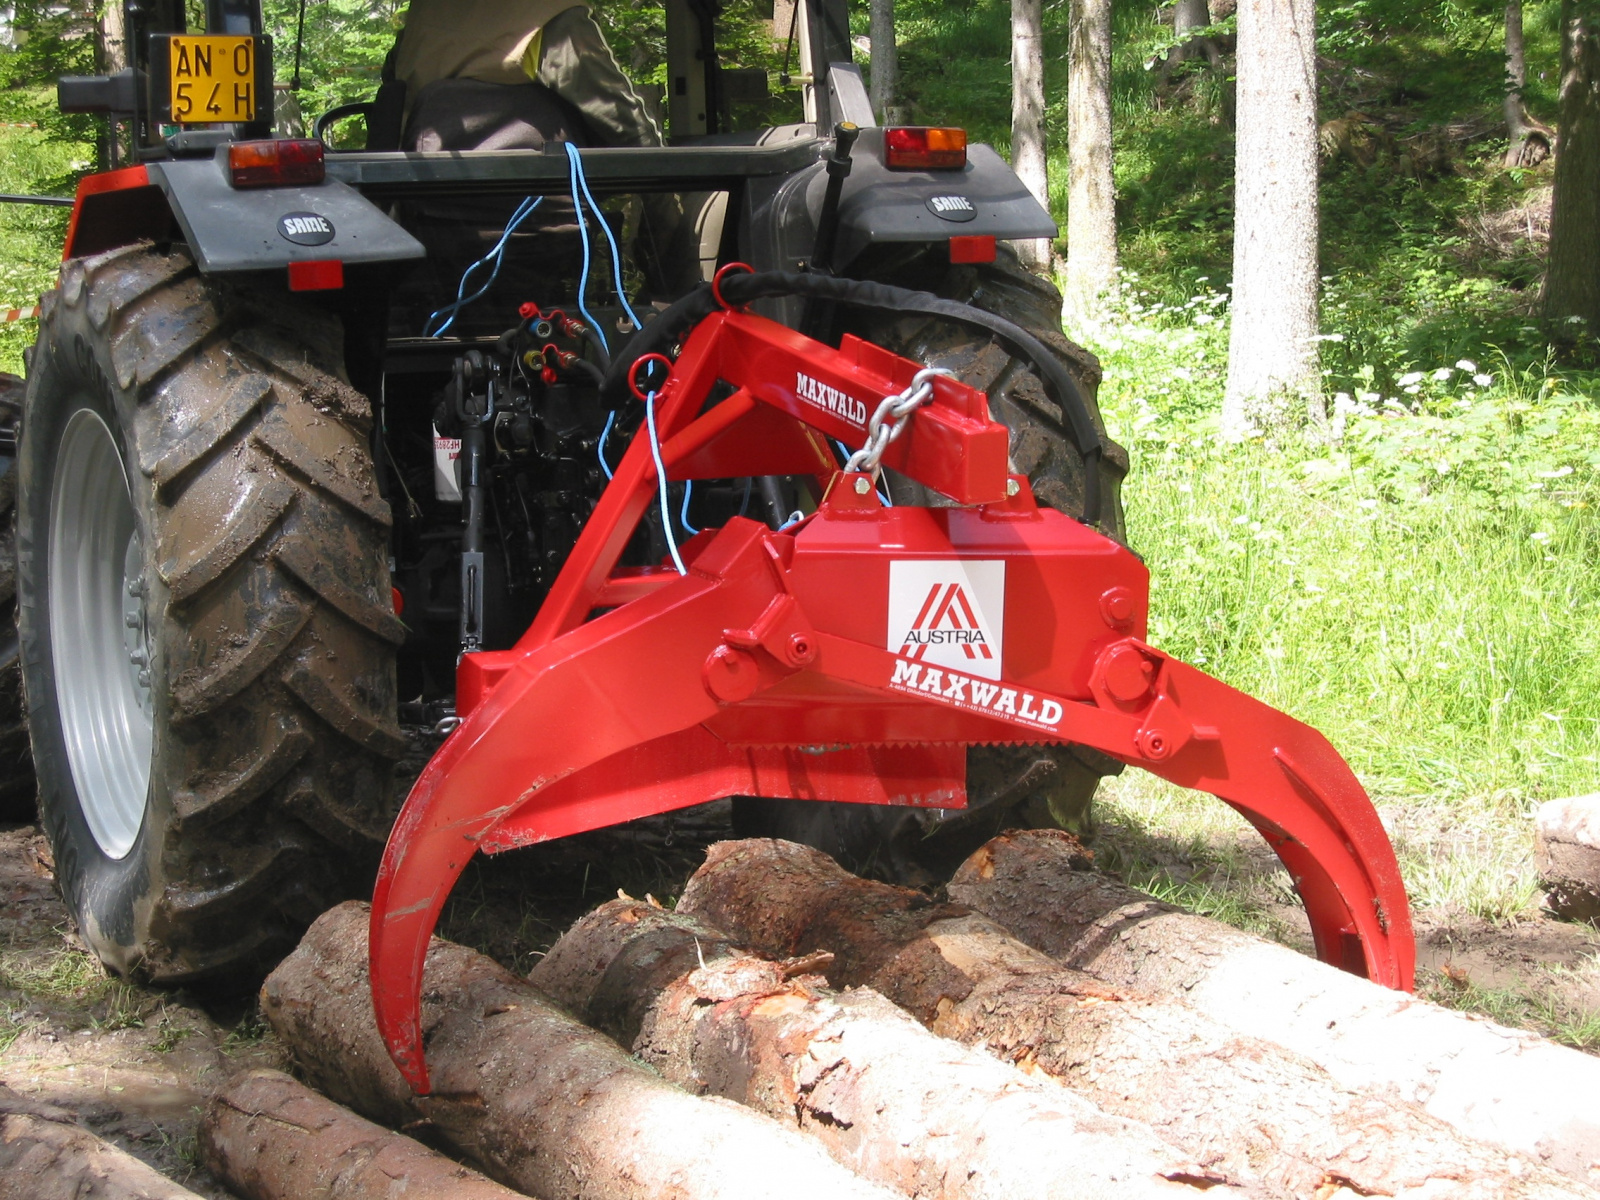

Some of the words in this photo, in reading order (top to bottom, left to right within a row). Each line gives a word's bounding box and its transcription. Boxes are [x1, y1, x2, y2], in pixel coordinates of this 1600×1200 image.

[176, 44, 212, 77] AN
[930, 196, 974, 212] SAME
[283, 216, 331, 235] SAME
[796, 371, 867, 425] MAXWALD
[904, 630, 986, 644] AUSTRIA
[890, 659, 1063, 725] MAXWALD
